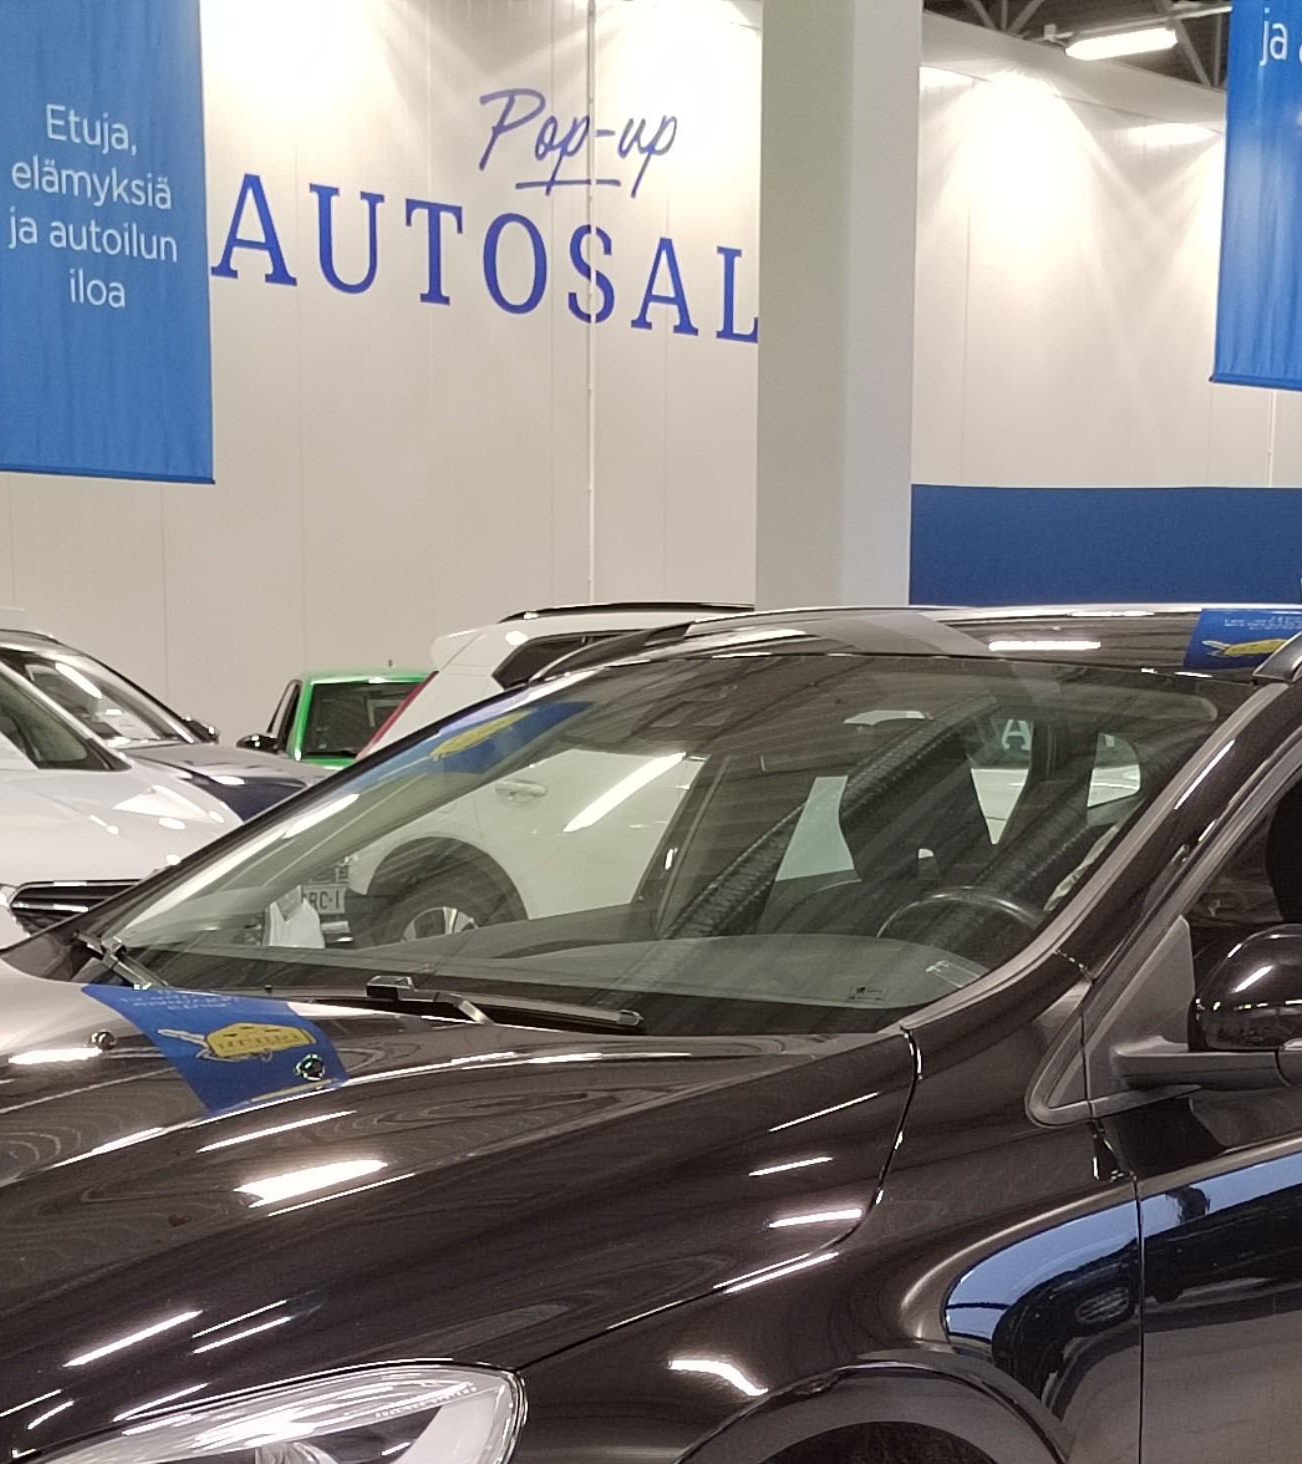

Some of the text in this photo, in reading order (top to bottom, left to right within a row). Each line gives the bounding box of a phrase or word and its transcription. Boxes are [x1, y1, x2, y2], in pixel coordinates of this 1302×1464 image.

[1259, 7, 1289, 66] ja
[44, 103, 138, 155] Etuja,
[479, 88, 678, 198] Pop-up
[10, 157, 173, 212] elämyksiä
[7, 207, 179, 264] ja autoilun
[210, 173, 760, 345] AUTOSAL
[68, 269, 127, 310] iloa
